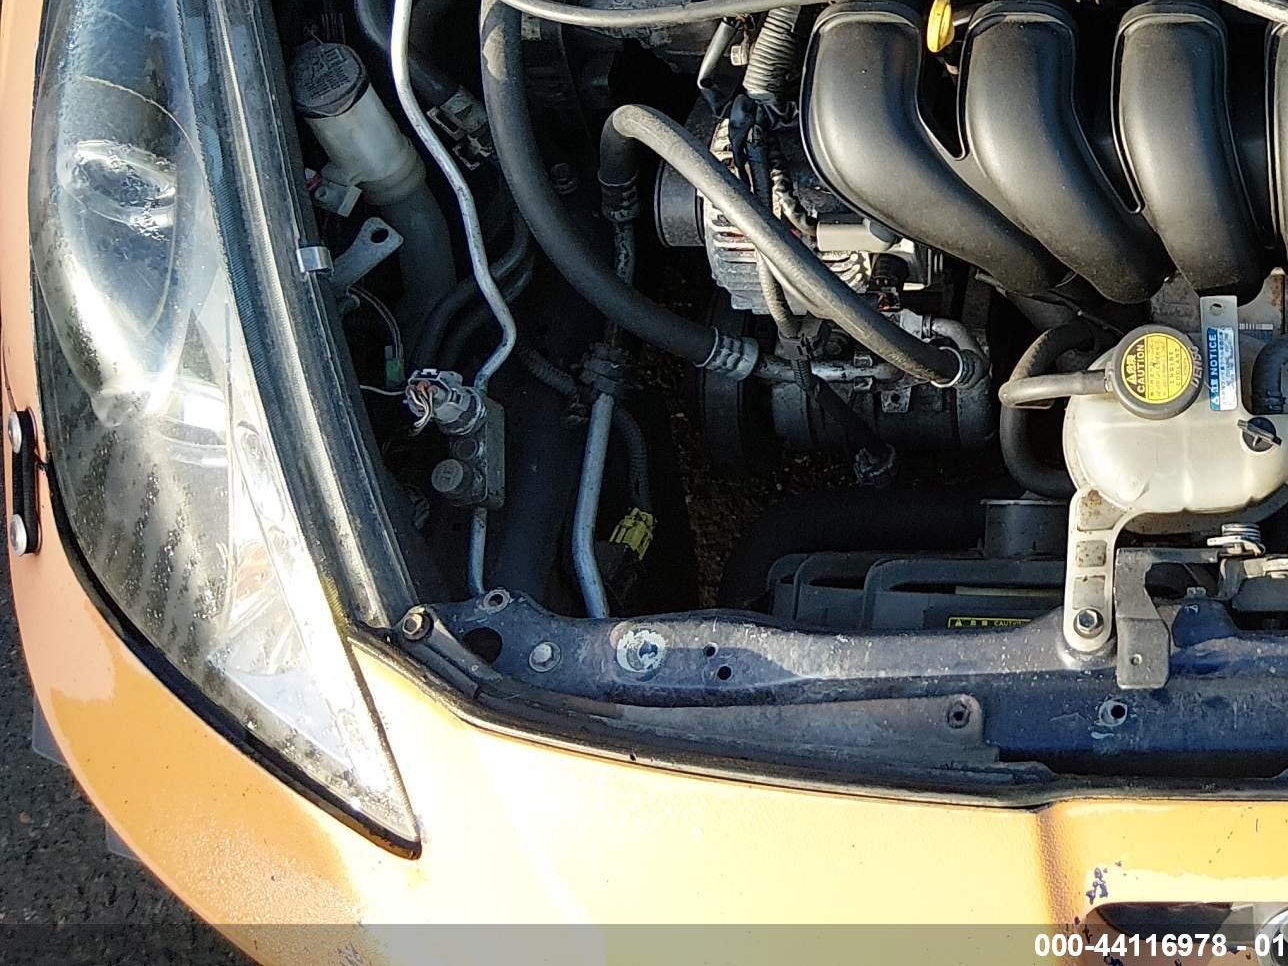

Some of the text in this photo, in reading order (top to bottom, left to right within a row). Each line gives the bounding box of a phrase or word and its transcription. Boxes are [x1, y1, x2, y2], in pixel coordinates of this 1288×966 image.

[1136, 344, 1146, 394] CAUTION
[1190, 345, 1203, 388] DENSO
[1208, 334, 1218, 377] NOTICE
